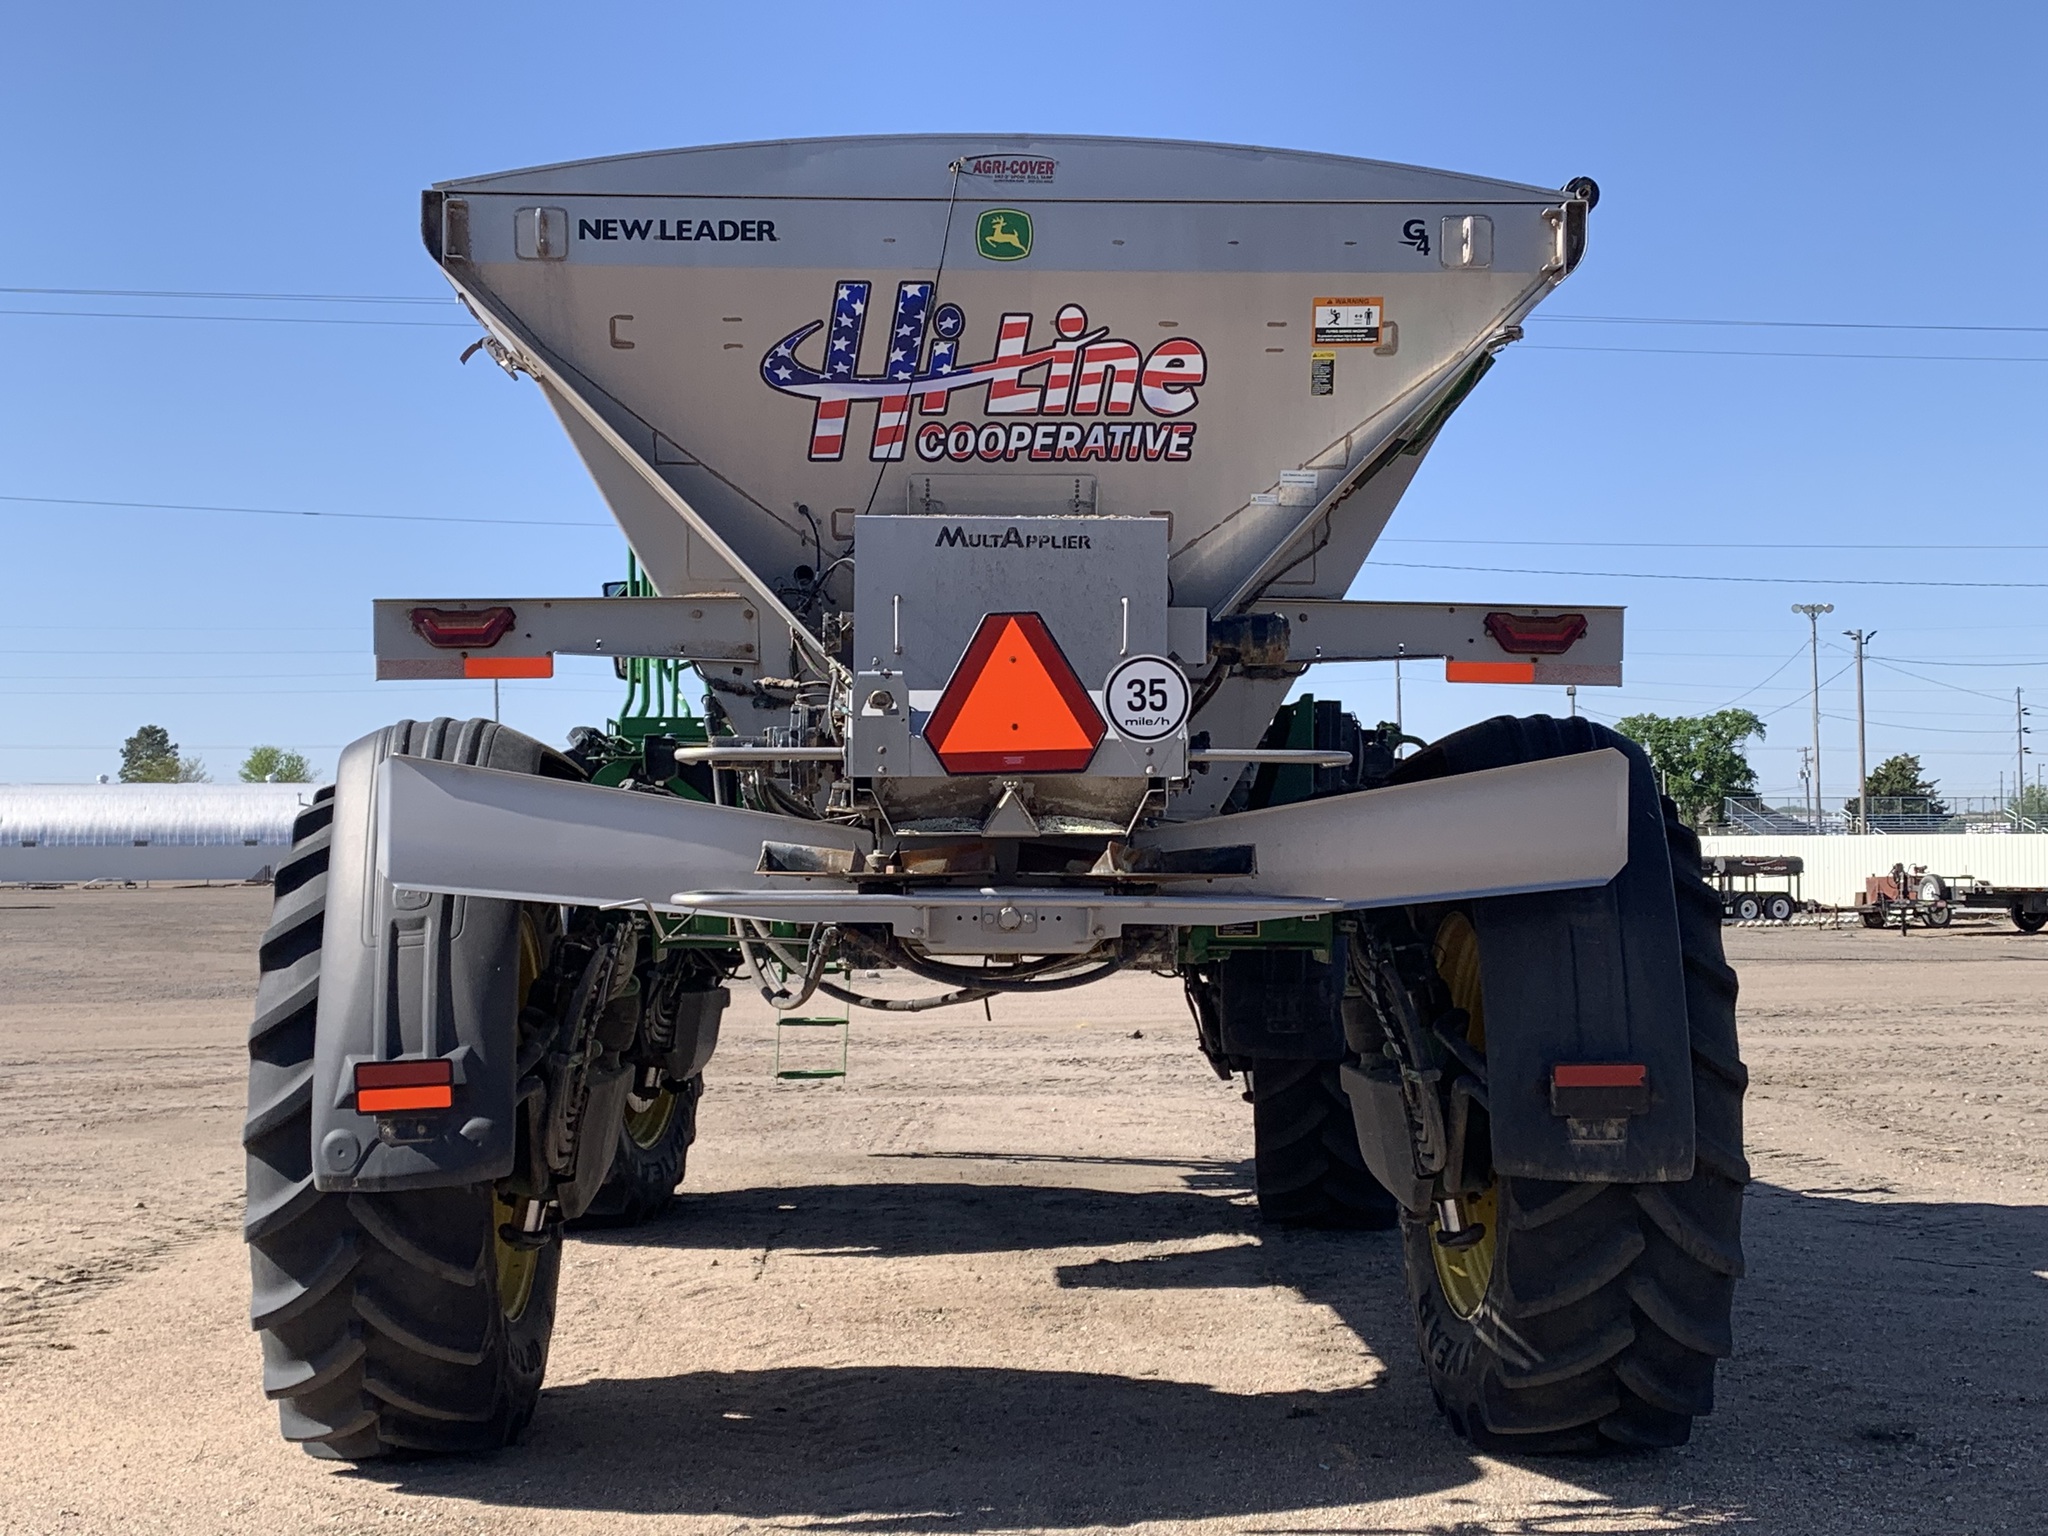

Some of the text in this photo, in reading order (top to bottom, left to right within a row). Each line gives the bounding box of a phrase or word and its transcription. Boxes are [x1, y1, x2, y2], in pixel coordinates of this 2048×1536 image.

[972, 160, 1055, 174] AGRI-COVER
[578, 219, 778, 242] NEW LEADER
[914, 421, 1197, 463] COOPERATIVE
[1126, 678, 1168, 712] 35
[1124, 716, 1170, 726] mile/h
